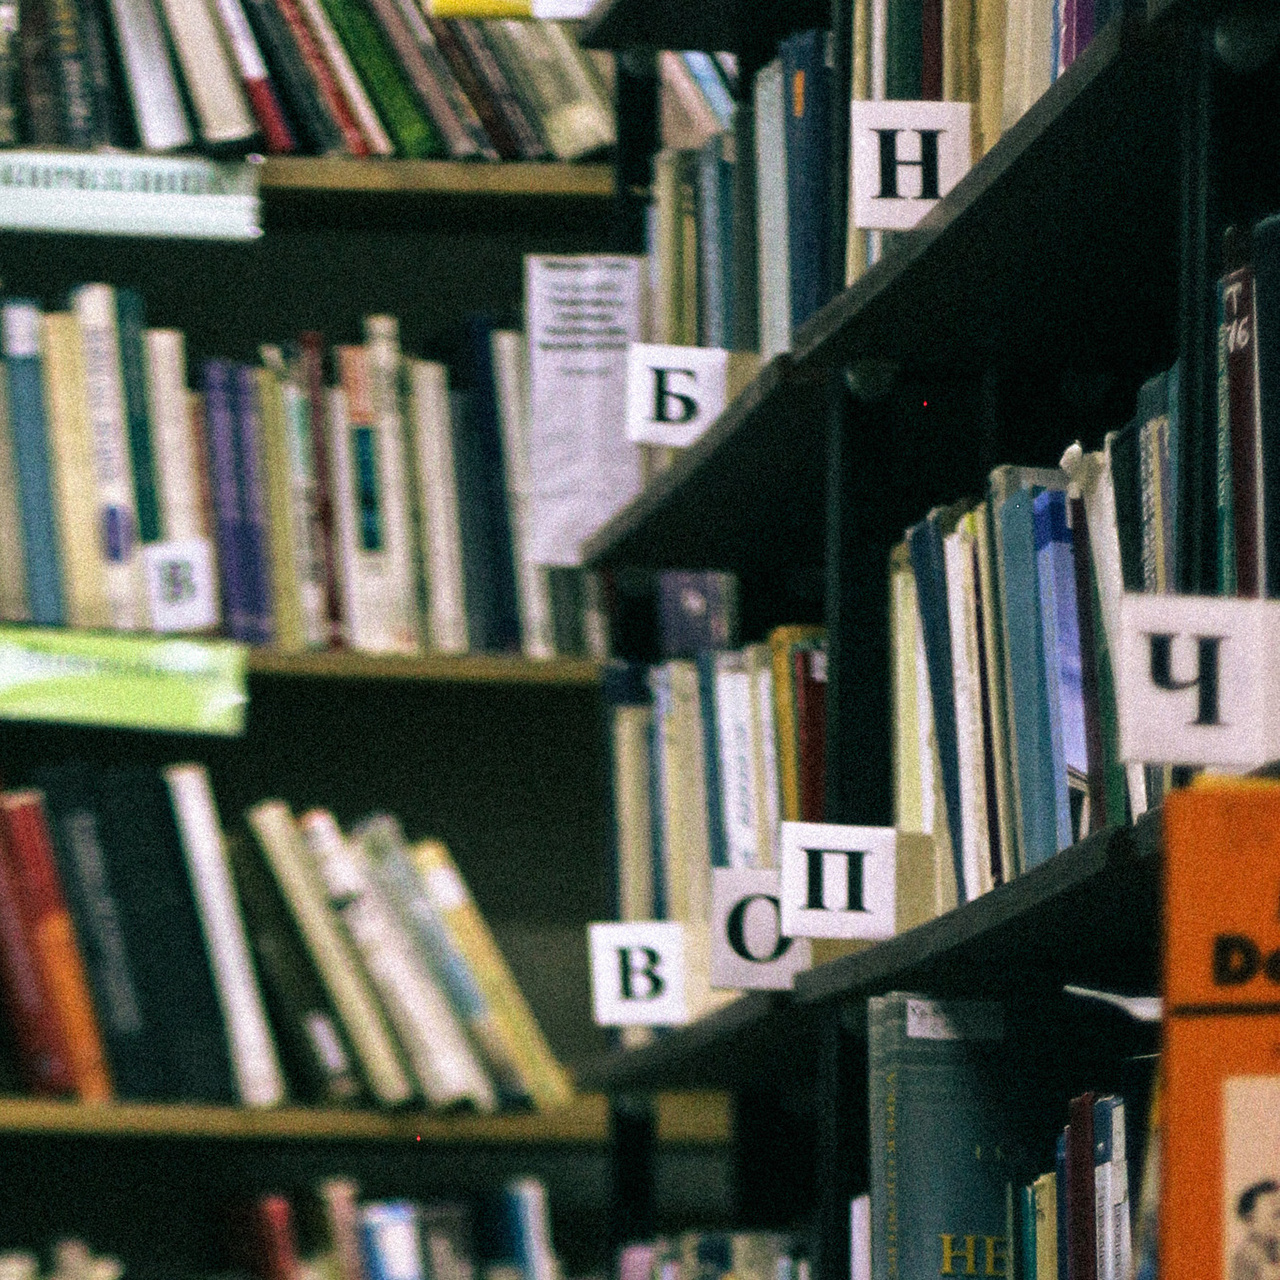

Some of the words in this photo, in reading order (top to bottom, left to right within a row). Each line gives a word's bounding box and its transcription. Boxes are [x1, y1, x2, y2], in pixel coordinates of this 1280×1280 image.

[871, 128, 948, 202] Н
[651, 367, 700, 425] Б
[1142, 632, 1232, 727] Ч
[804, 847, 868, 913] П
[616, 945, 666, 1002] В
